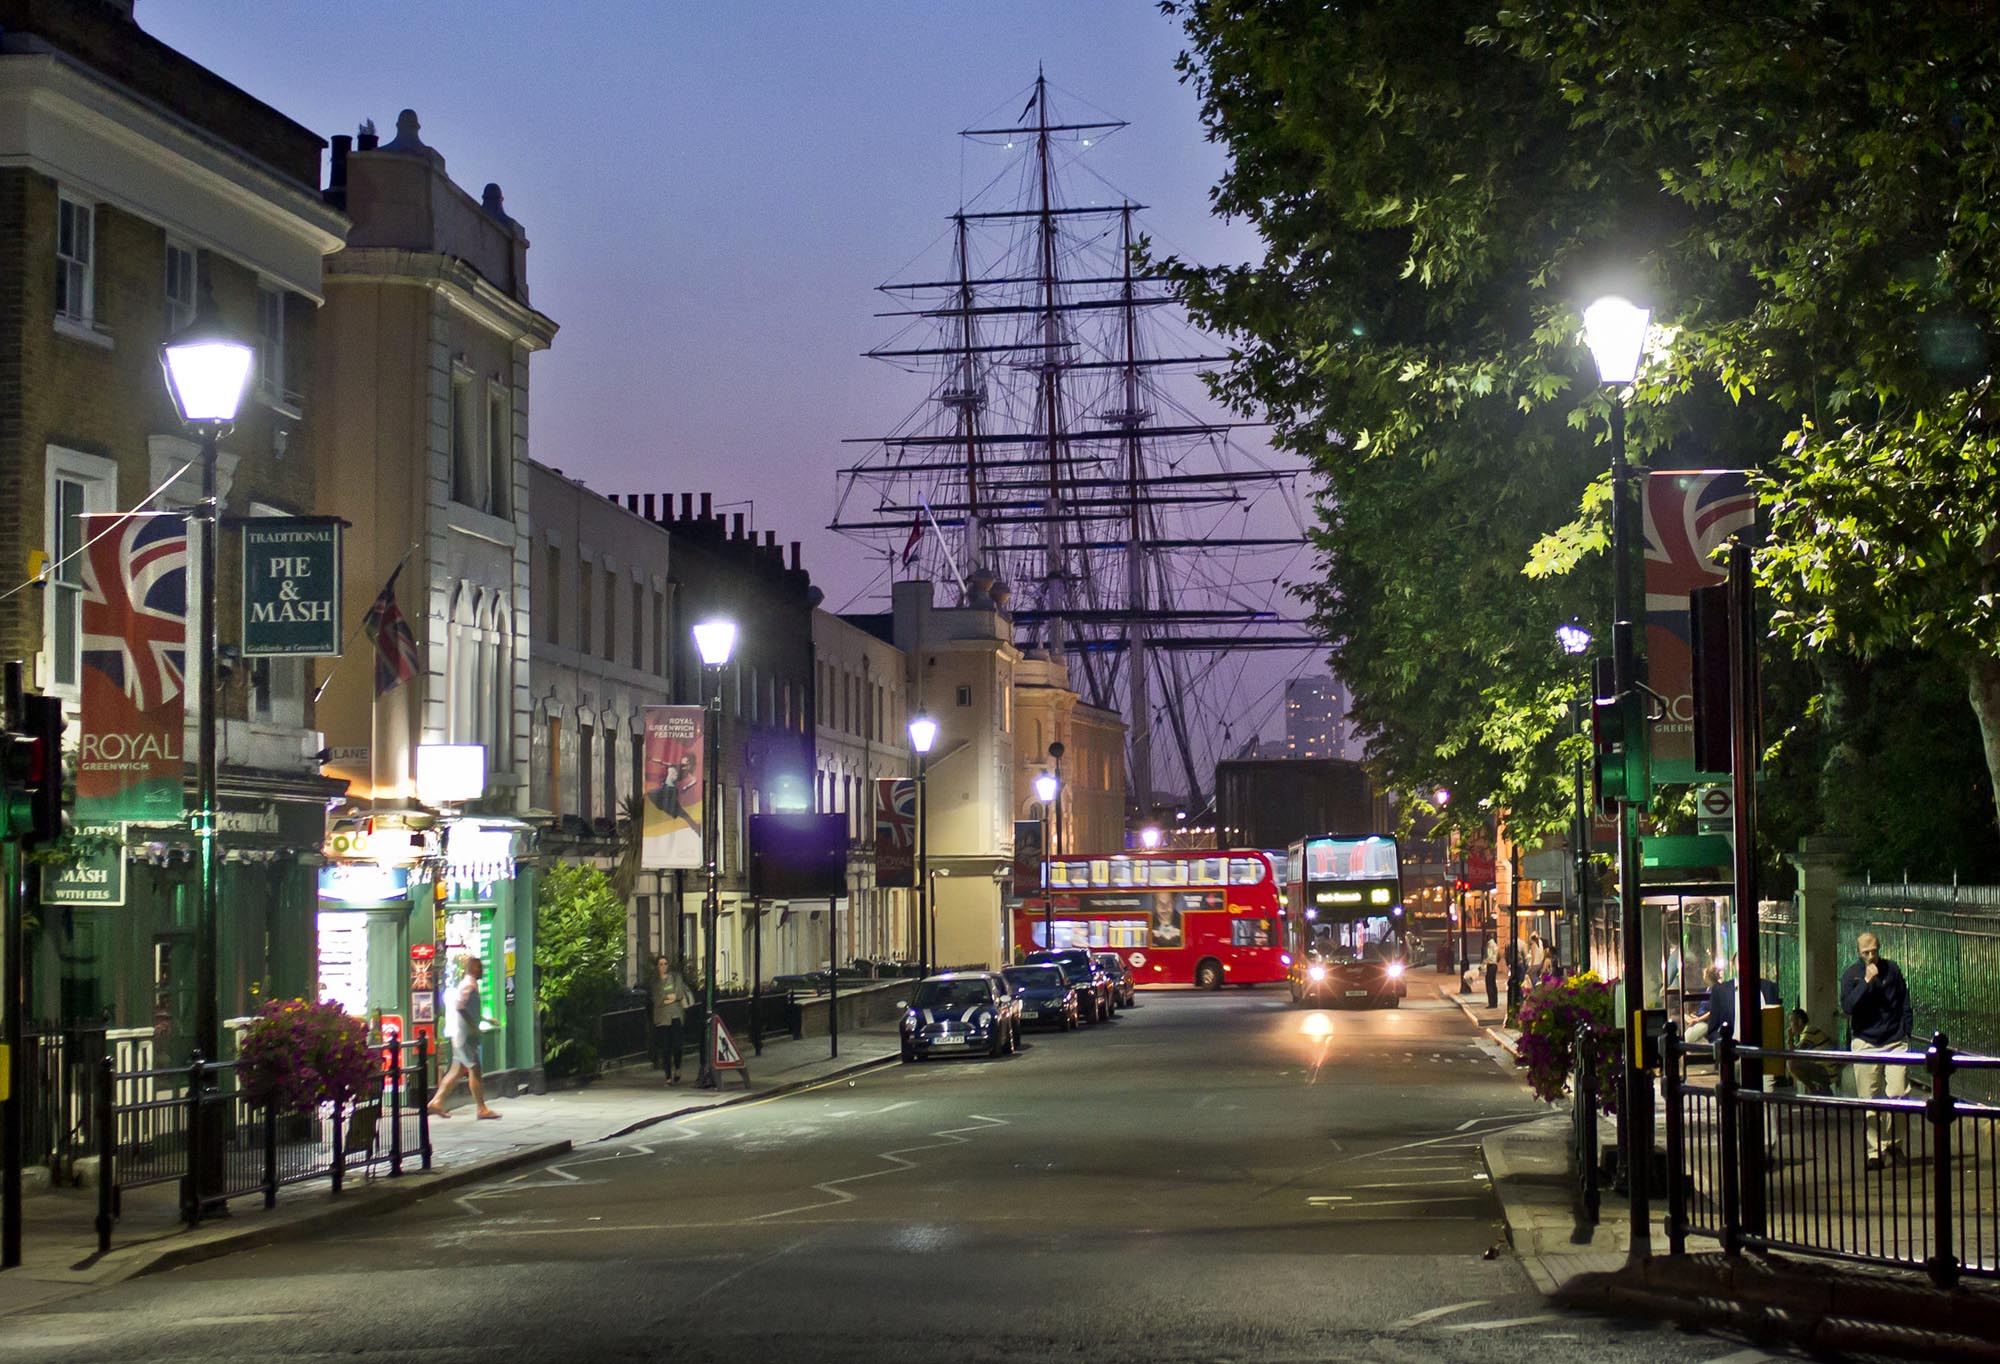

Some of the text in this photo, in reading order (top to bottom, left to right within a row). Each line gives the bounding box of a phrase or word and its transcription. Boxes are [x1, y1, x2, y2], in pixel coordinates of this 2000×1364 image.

[249, 532, 331, 543] TRADITIONAL
[269, 557, 311, 577] PIE
[279, 580, 300, 600] &
[250, 601, 331, 622] MASH
[1654, 724, 1693, 732] GREEN
[82, 733, 179, 760] ROYAL
[334, 749, 368, 759] LANE
[82, 762, 149, 771] GREENWICH
[59, 870, 108, 883] MASH
[56, 890, 110, 900] WITH EELS
